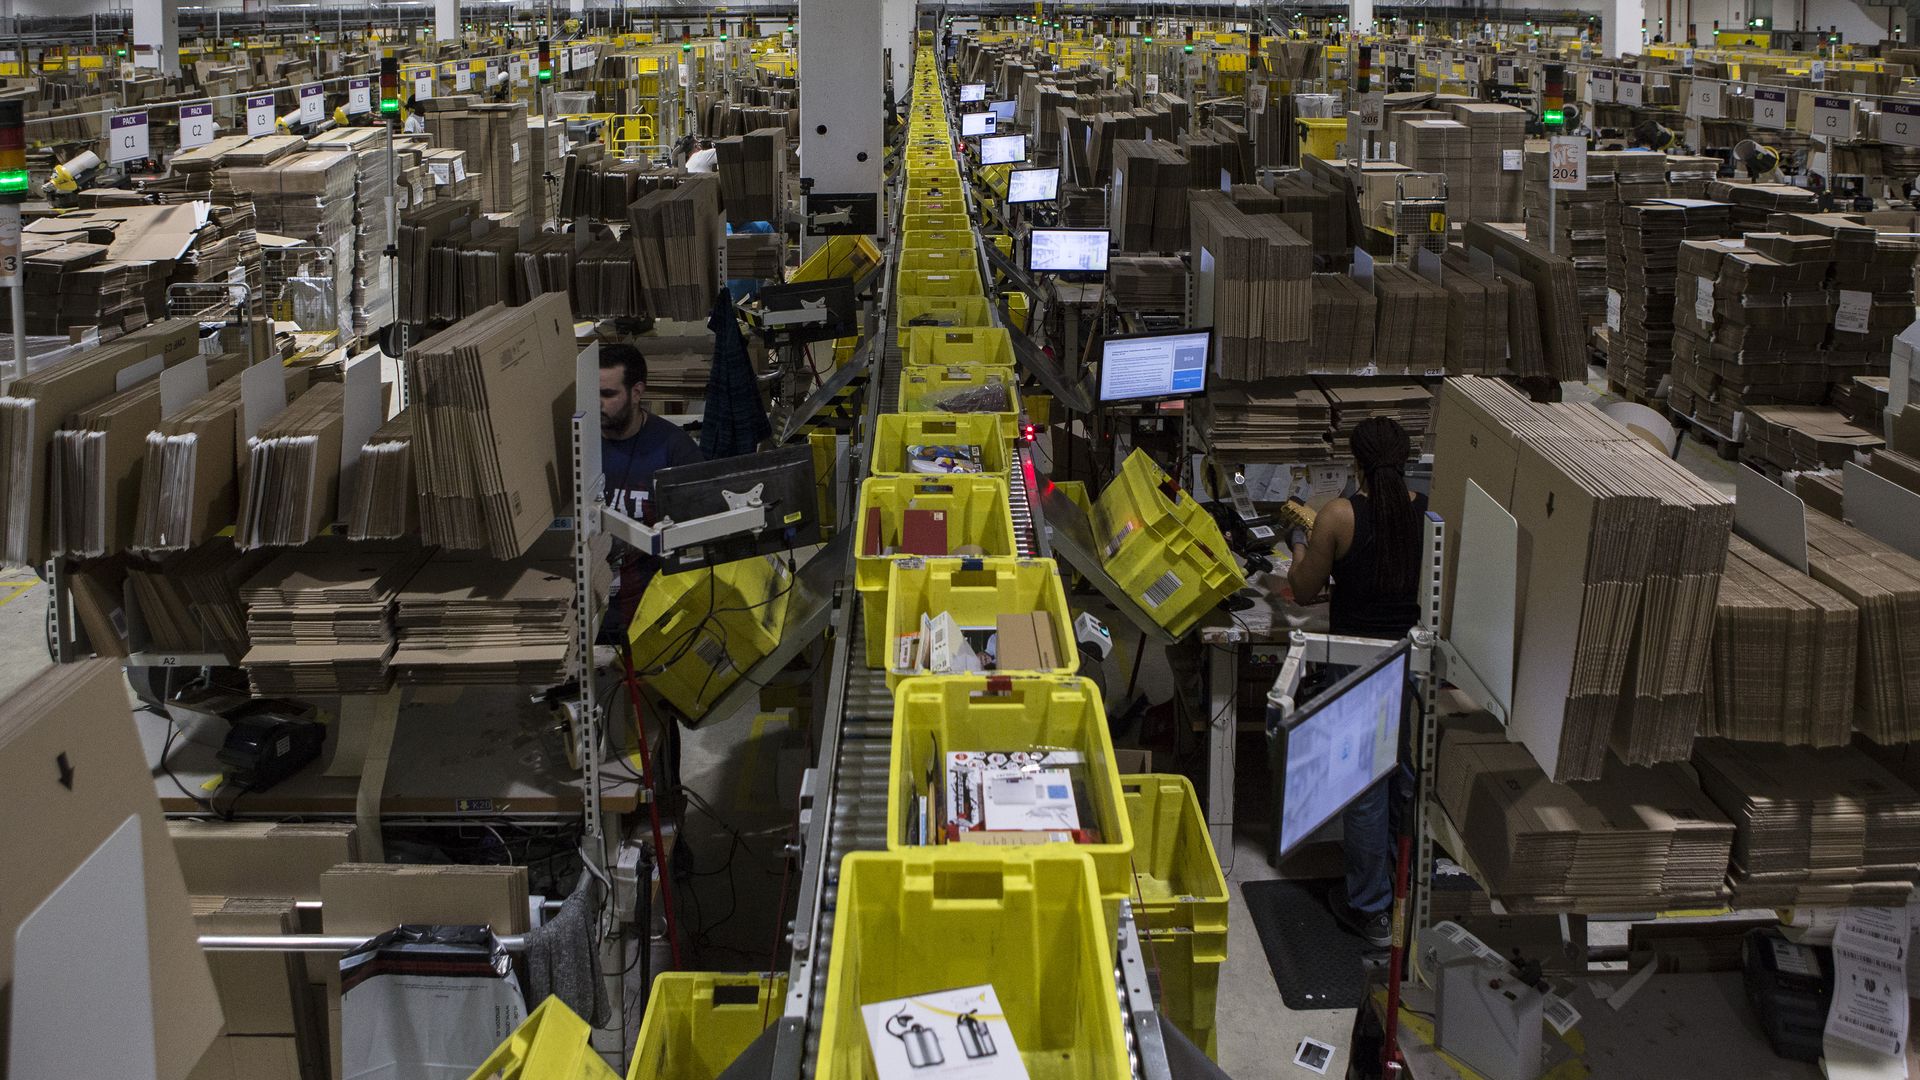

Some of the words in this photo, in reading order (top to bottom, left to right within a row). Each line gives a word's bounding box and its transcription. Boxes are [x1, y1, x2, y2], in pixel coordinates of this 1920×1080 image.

[1764, 92, 1775, 100] PACK
[255, 98, 267, 106] PACK
[309, 101, 317, 112] C4
[1825, 99, 1839, 107] PACK
[190, 106, 203, 115] PACK
[1764, 107, 1774, 118] C4
[1894, 105, 1909, 114] PACK
[122, 116, 136, 126] PACK
[257, 114, 266, 126] C3
[1826, 116, 1837, 127] C3
[192, 125, 202, 137] C2
[1895, 122, 1908, 135] C2
[124, 136, 135, 149] C1
[1552, 168, 1578, 180] 204
[163, 657, 176, 665] A2
